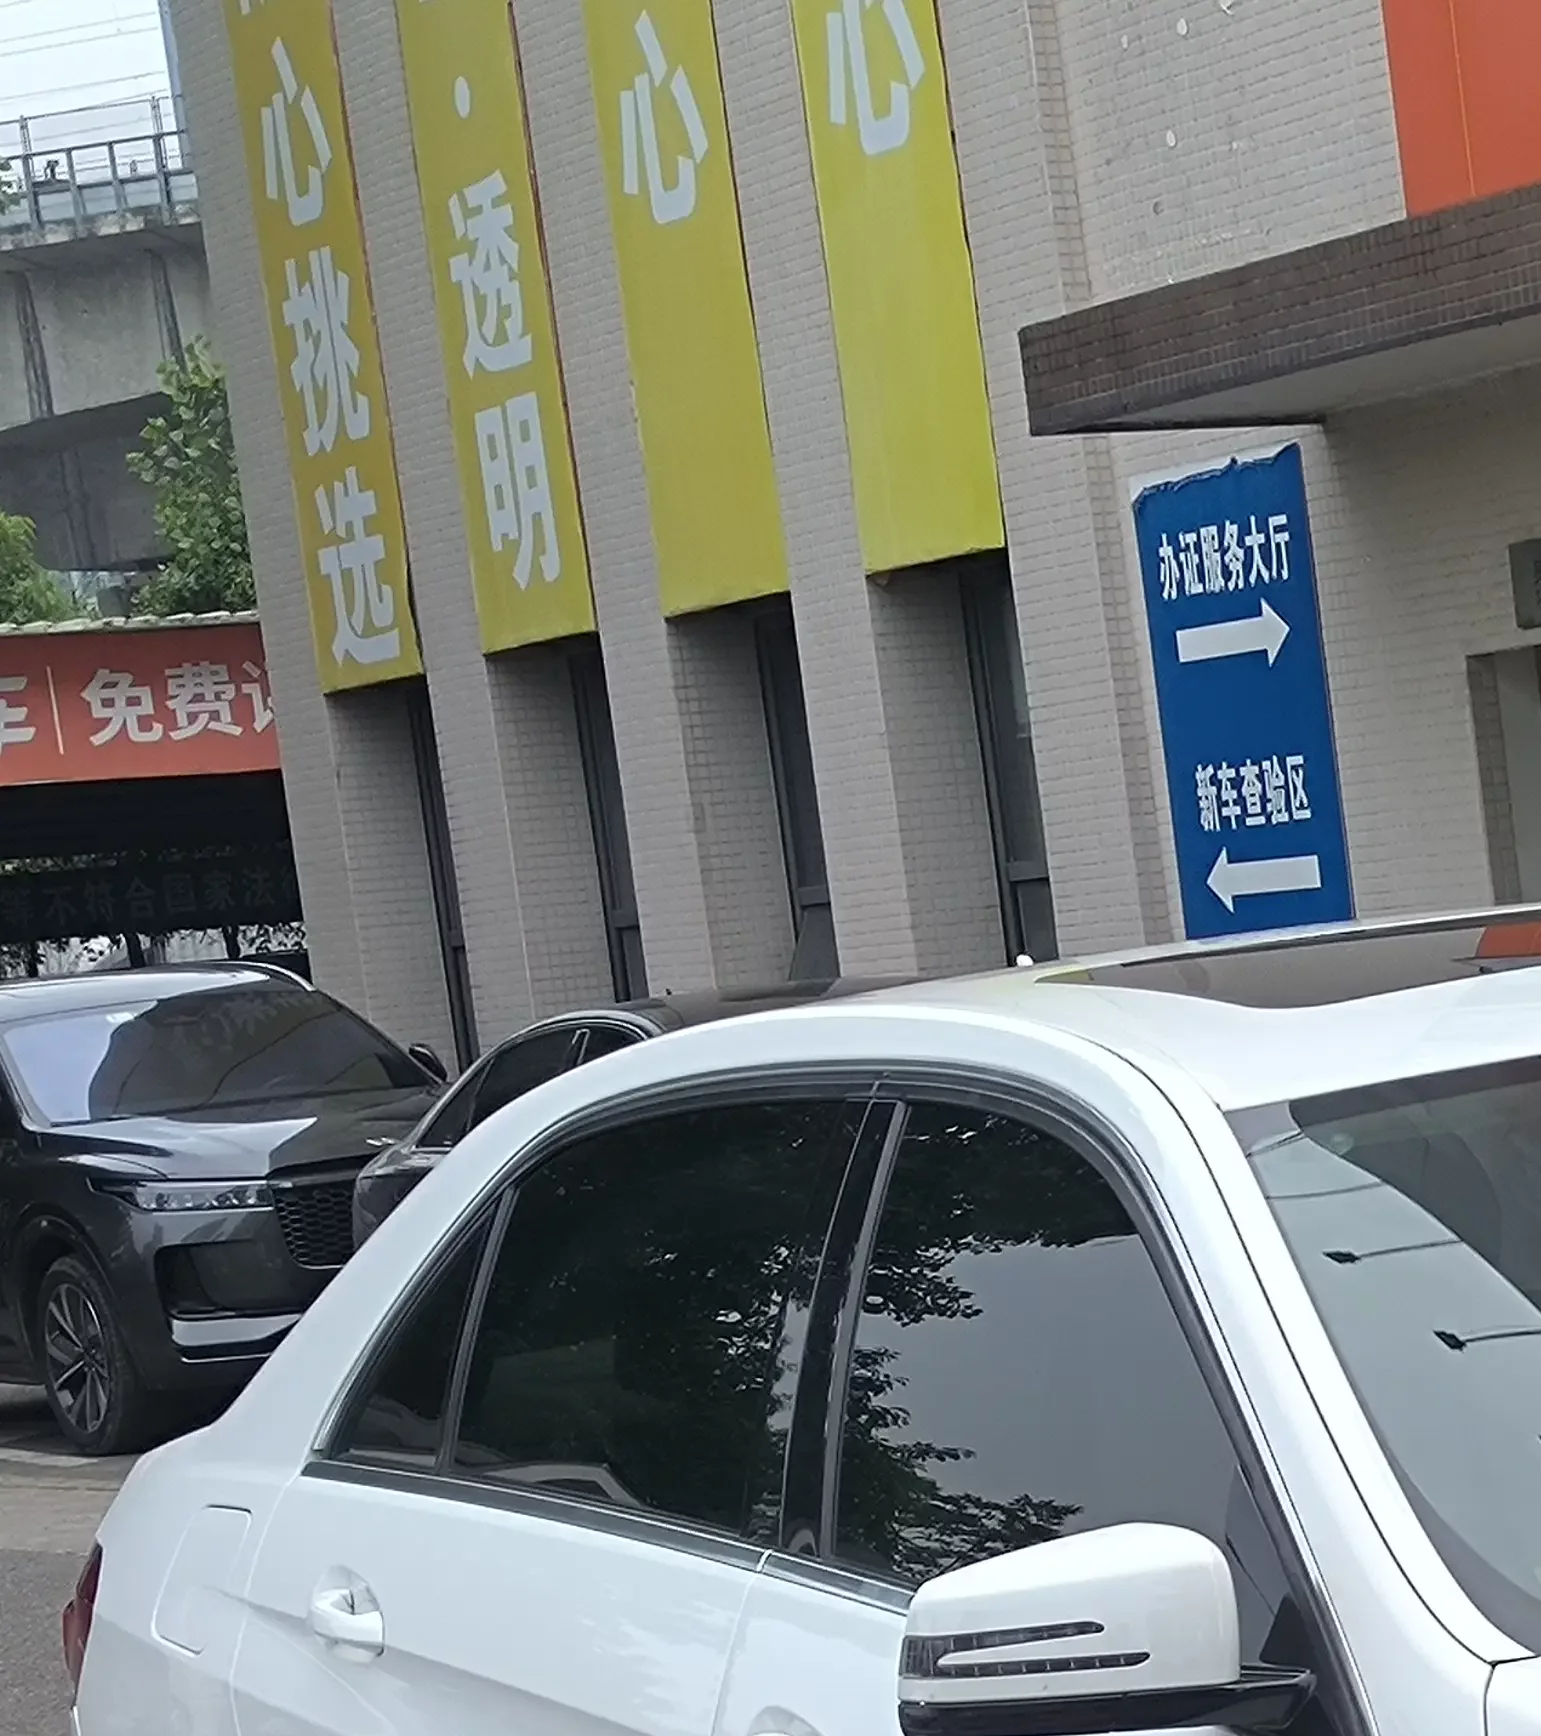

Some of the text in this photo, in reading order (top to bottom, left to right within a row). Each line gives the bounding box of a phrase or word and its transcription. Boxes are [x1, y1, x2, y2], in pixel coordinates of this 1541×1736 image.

[619, 10, 709, 224] 心
[239, 0, 400, 667] 心挑选
[1158, 514, 1290, 600] 办证服务大厅
[1195, 755, 1312, 833] 新车查验区
